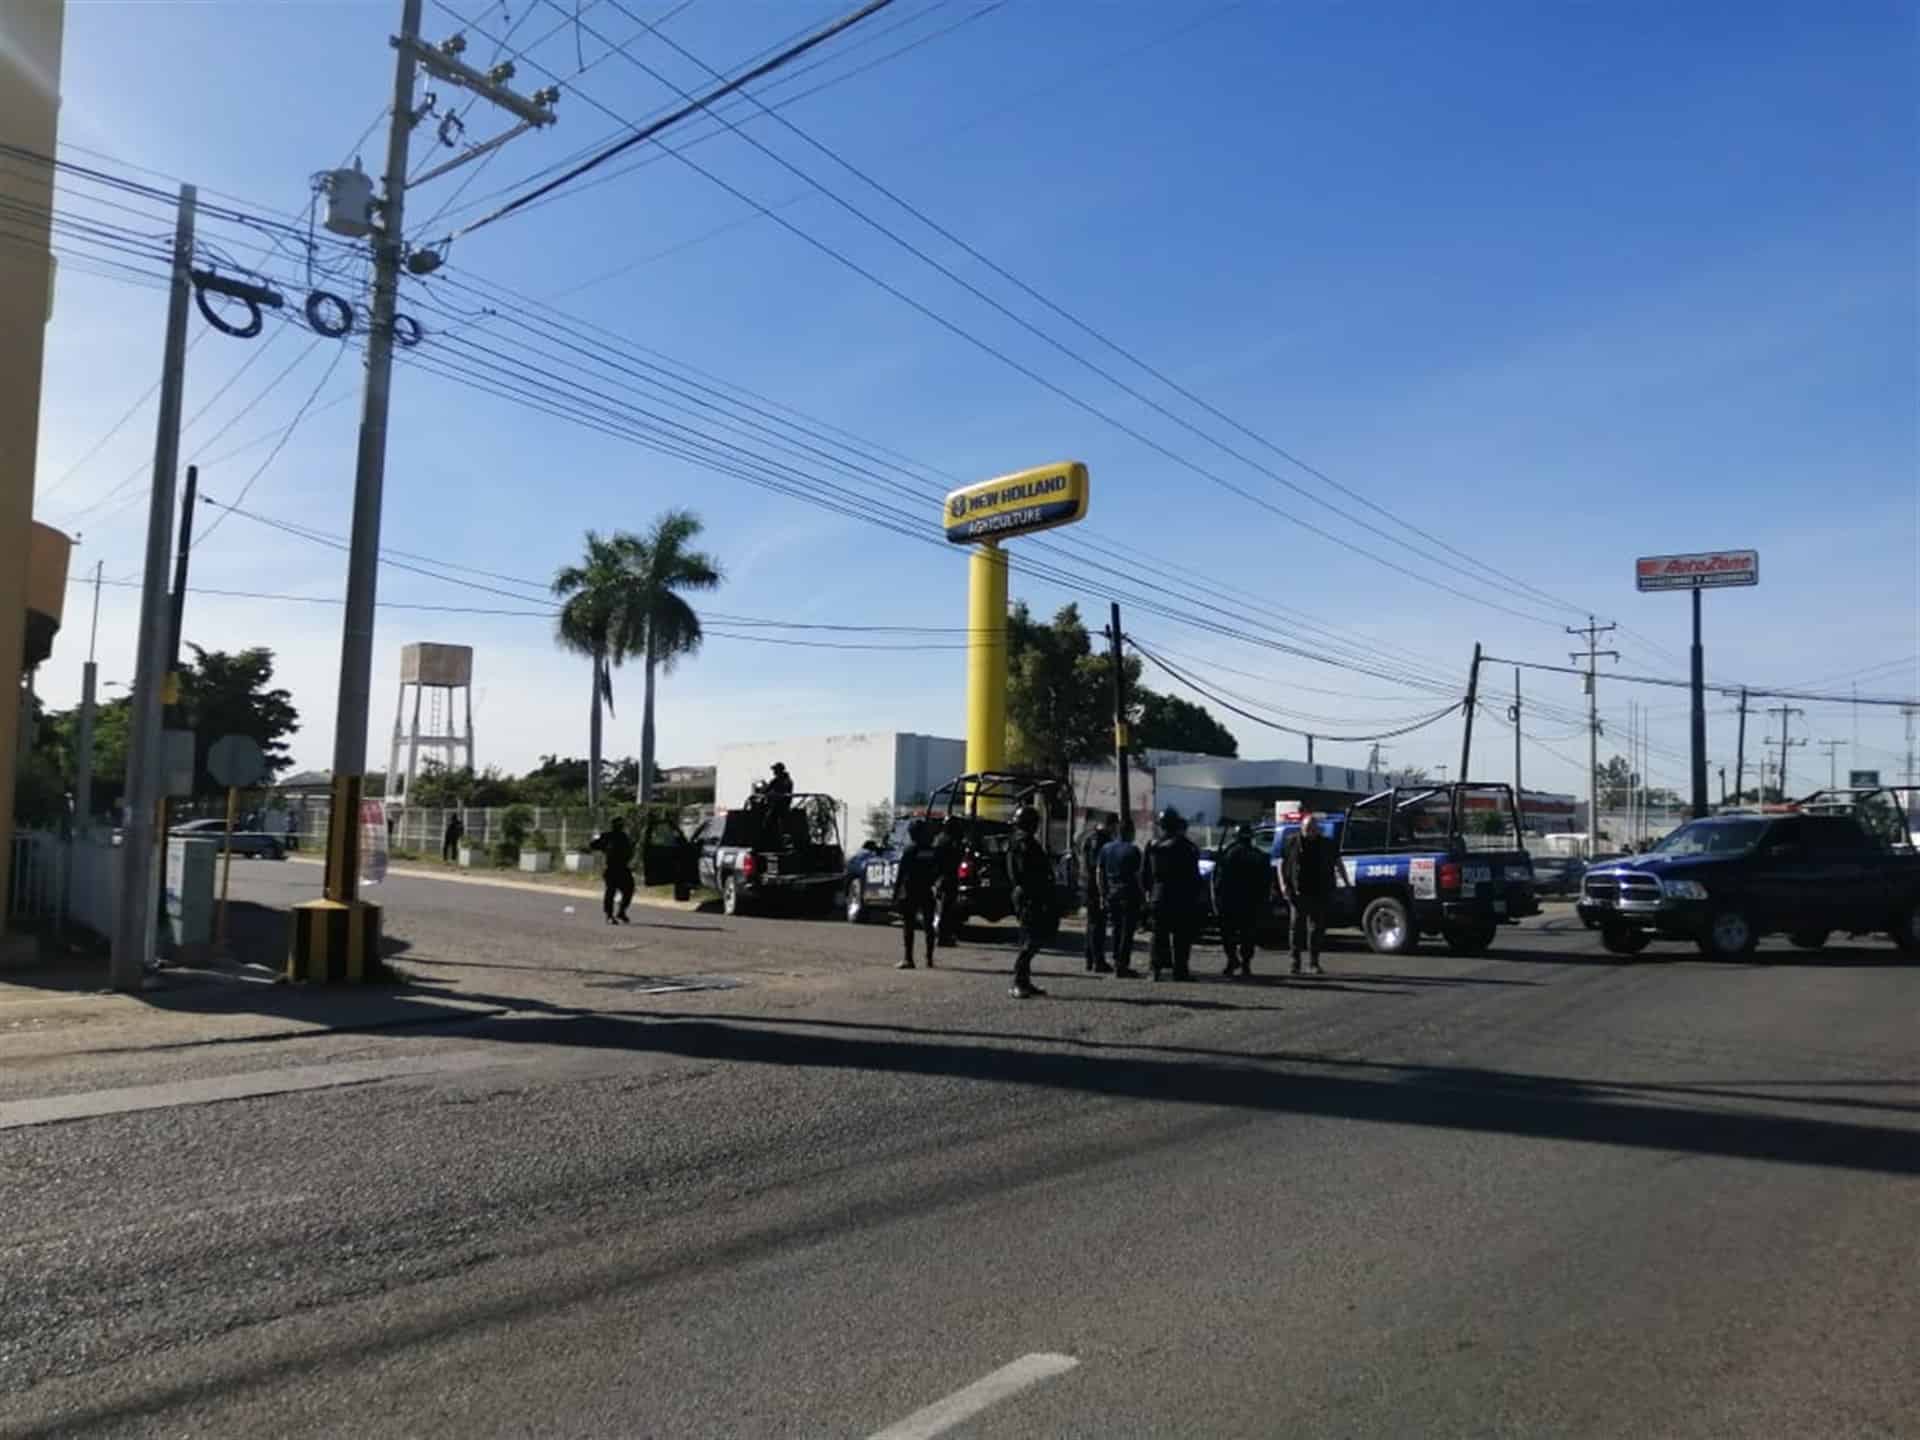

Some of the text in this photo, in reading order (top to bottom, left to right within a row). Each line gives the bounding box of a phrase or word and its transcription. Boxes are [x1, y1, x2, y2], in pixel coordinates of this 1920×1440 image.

[969, 475, 1066, 510] NEW HOLLAND
[968, 508, 1042, 536] AGRICULTURE
